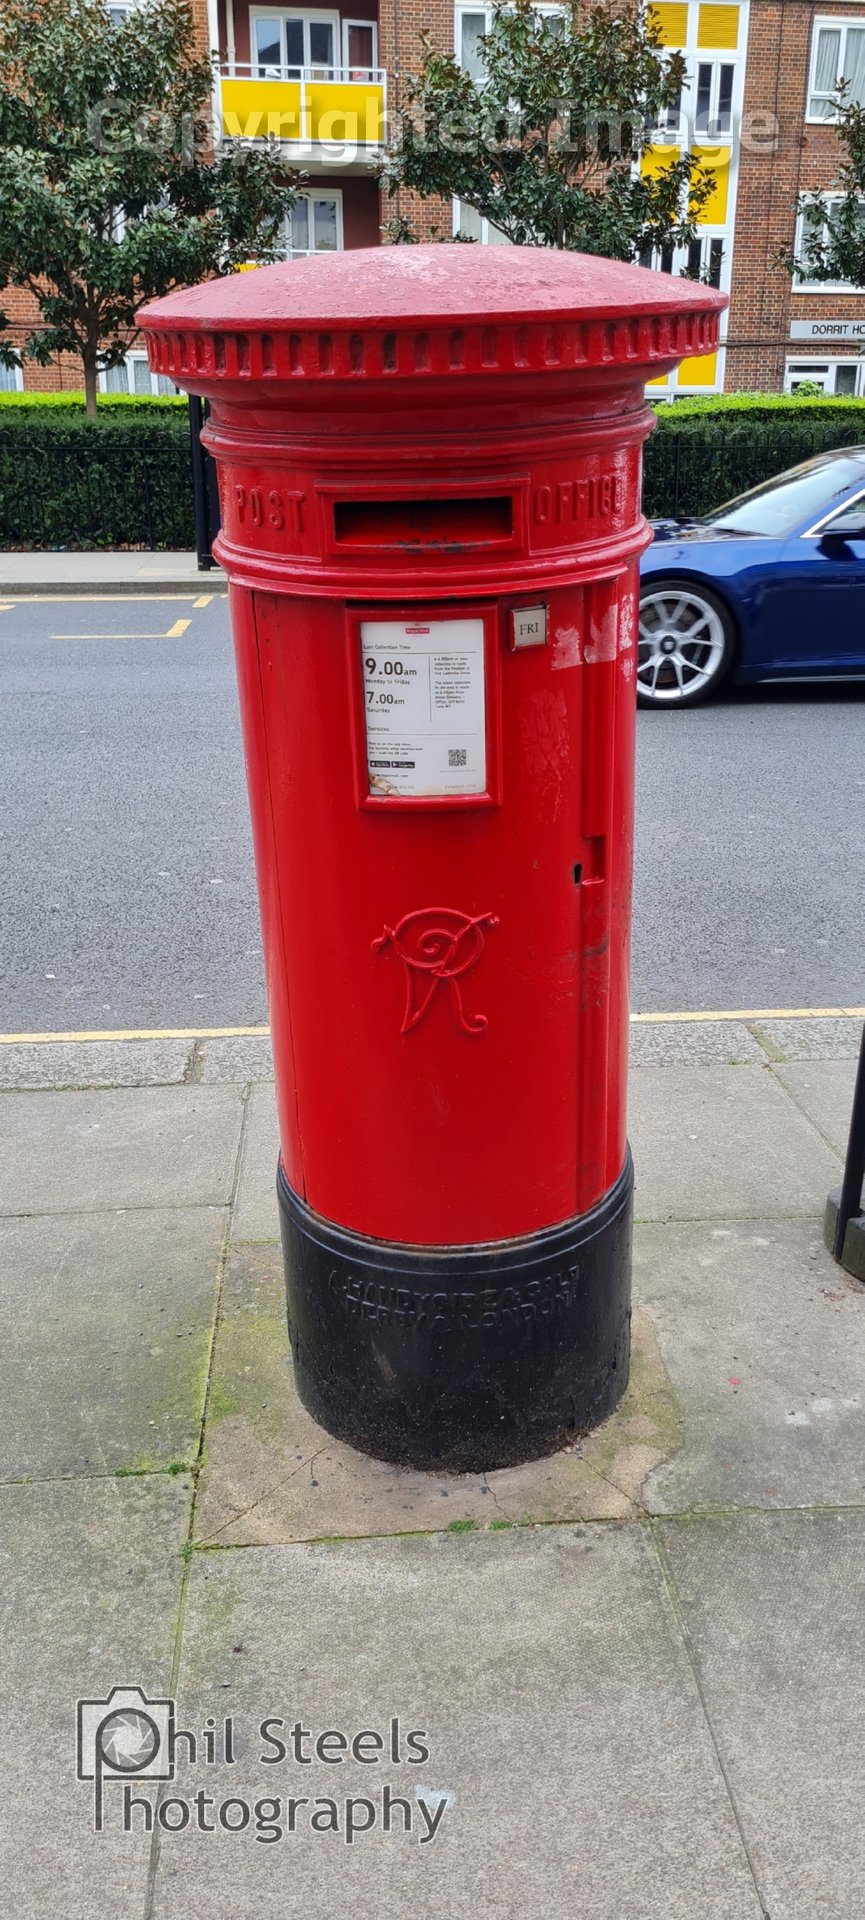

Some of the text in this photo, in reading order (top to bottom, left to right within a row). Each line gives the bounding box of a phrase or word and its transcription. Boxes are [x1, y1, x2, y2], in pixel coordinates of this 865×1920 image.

[812, 324, 849, 334] DORRIT
[531, 473, 627, 526] OFFICE
[235, 484, 305, 533] POST
[520, 622, 538, 636] FRI
[365, 658, 417, 676] 9.00am
[366, 692, 405, 704] 7.00am
